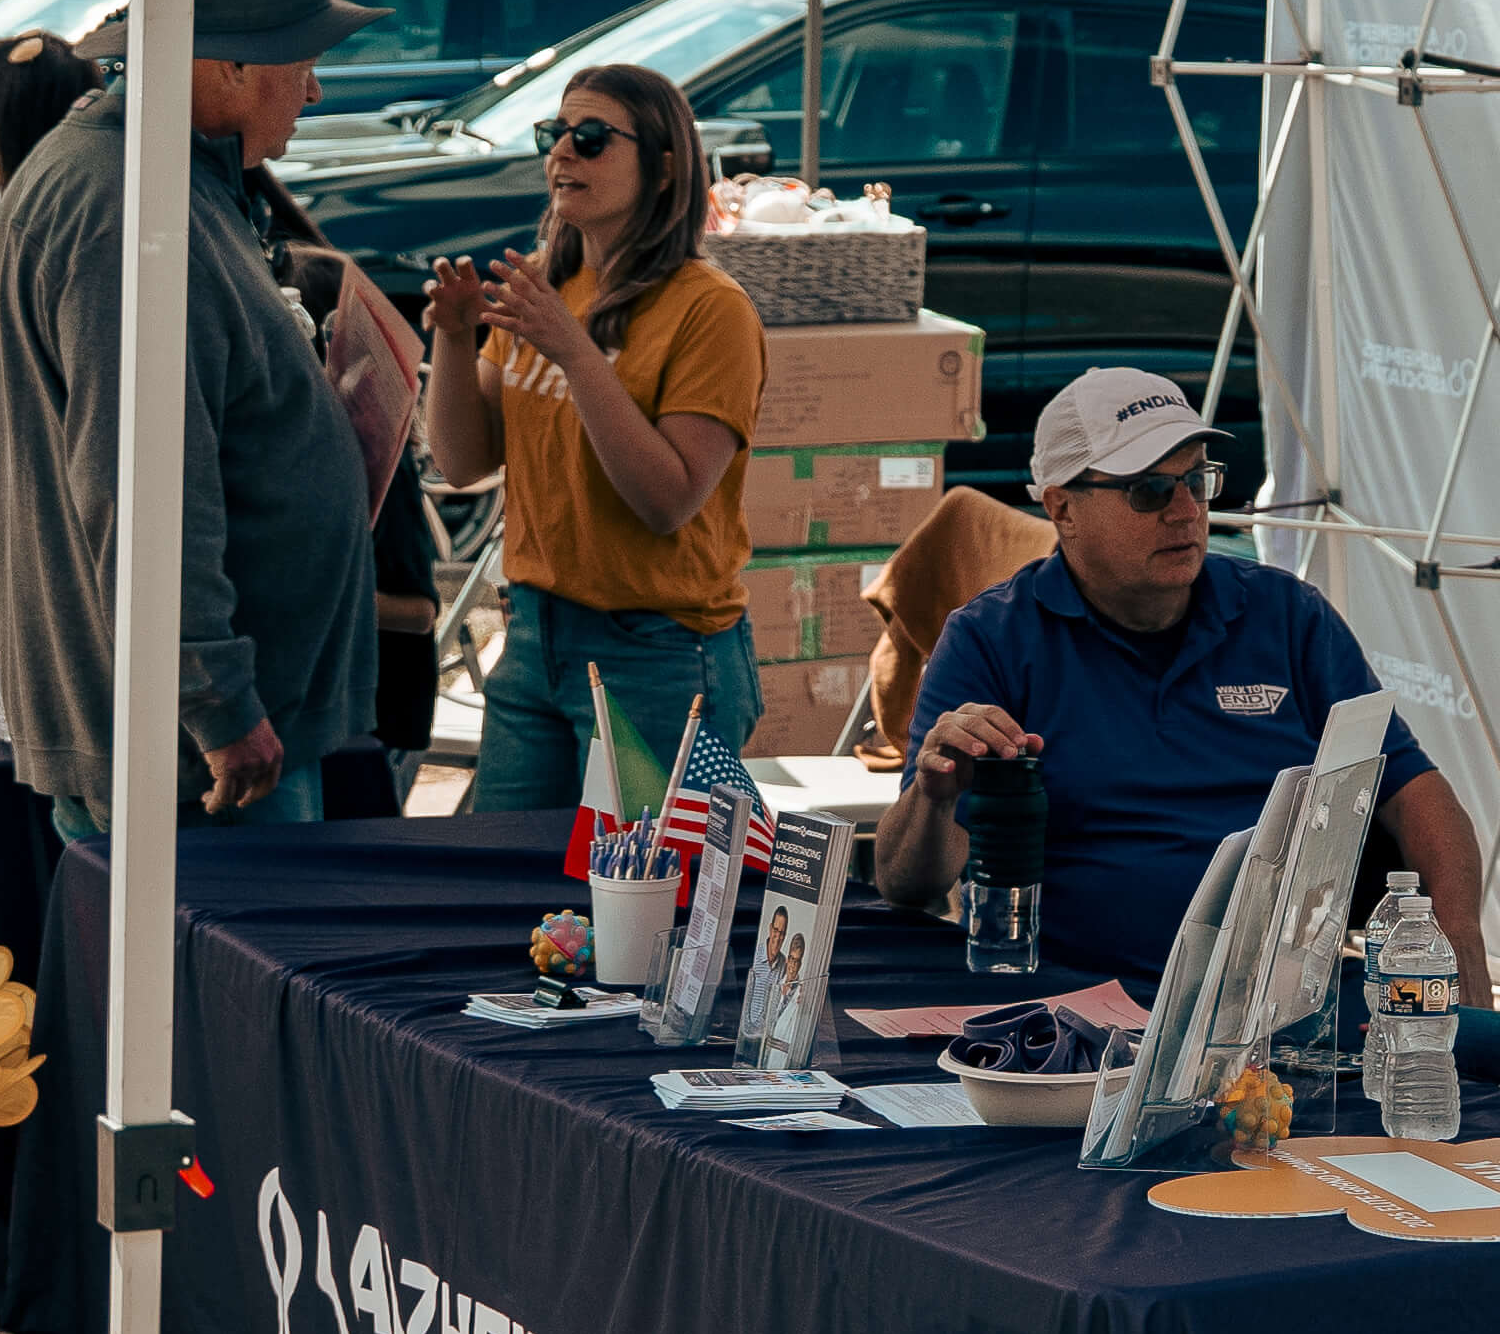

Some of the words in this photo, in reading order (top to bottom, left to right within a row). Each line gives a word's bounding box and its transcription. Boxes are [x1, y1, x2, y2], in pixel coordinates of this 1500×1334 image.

[1215, 685, 1246, 694] WALK
[1247, 684, 1261, 694] TO
[1220, 695, 1263, 704] END
[775, 840, 822, 860] UNDERSTANDING
[771, 865, 786, 876] AND
[1317, 1174, 1371, 1195] GRAND
[1356, 1194, 1404, 1216] ELITE
[1388, 1211, 1436, 1228] 2025
